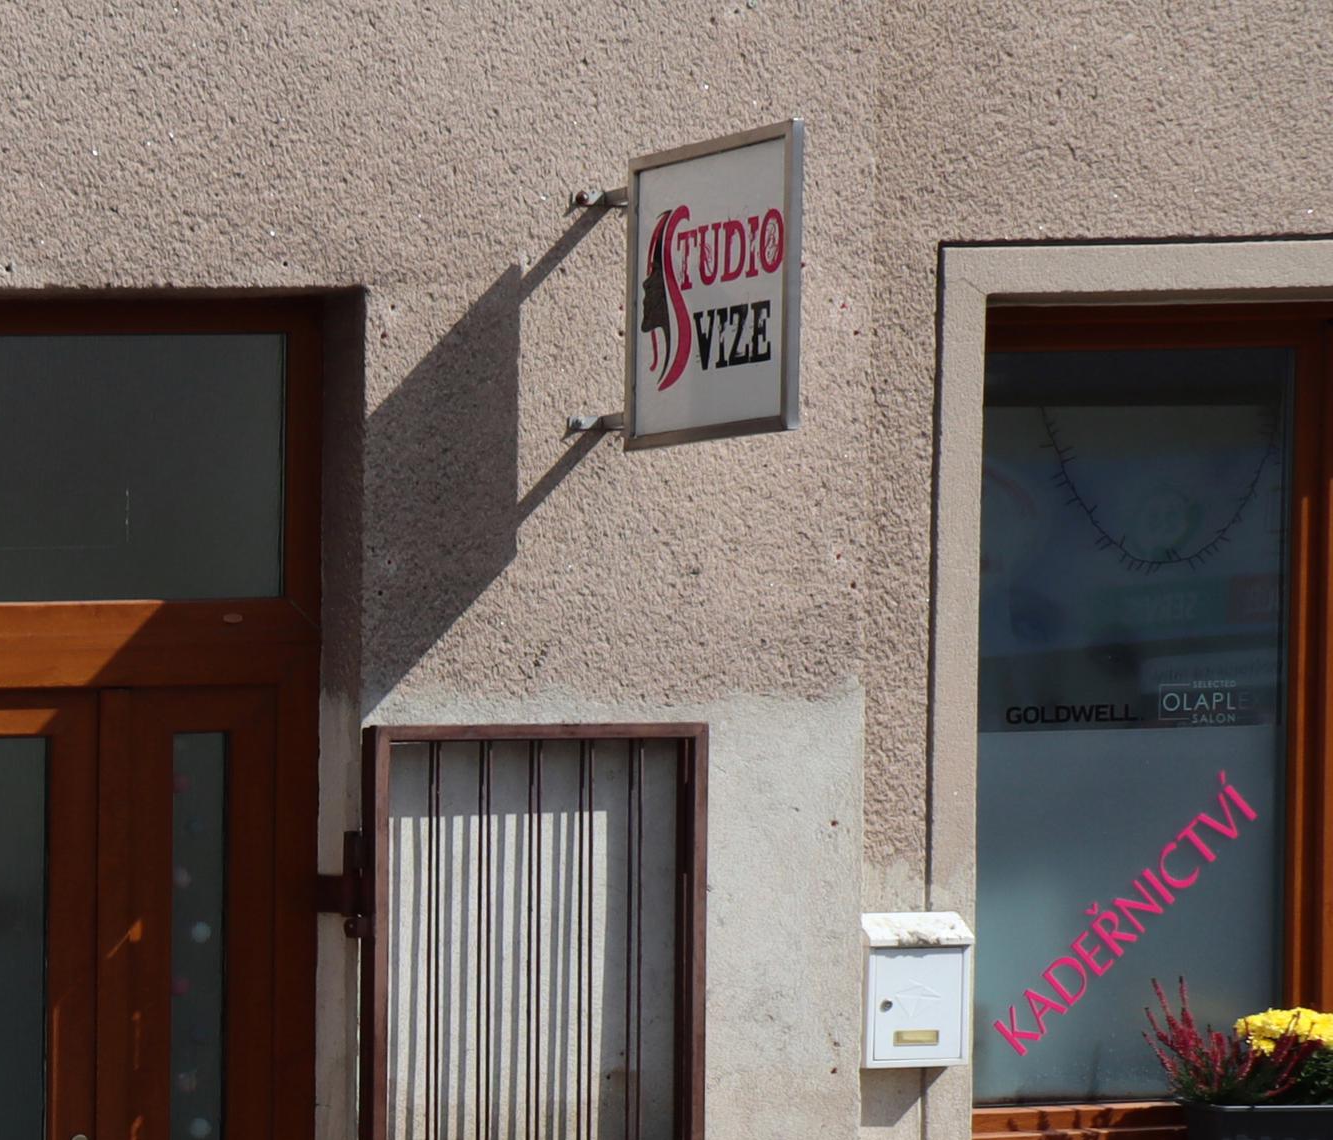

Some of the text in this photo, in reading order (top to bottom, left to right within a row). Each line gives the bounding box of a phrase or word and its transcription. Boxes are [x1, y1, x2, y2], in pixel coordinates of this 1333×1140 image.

[694, 300, 771, 370] VIZE
[1192, 680, 1237, 689] SELECTED
[1191, 713, 1236, 724] SALON
[993, 770, 1259, 1056] KADEŘNICTVÍ
